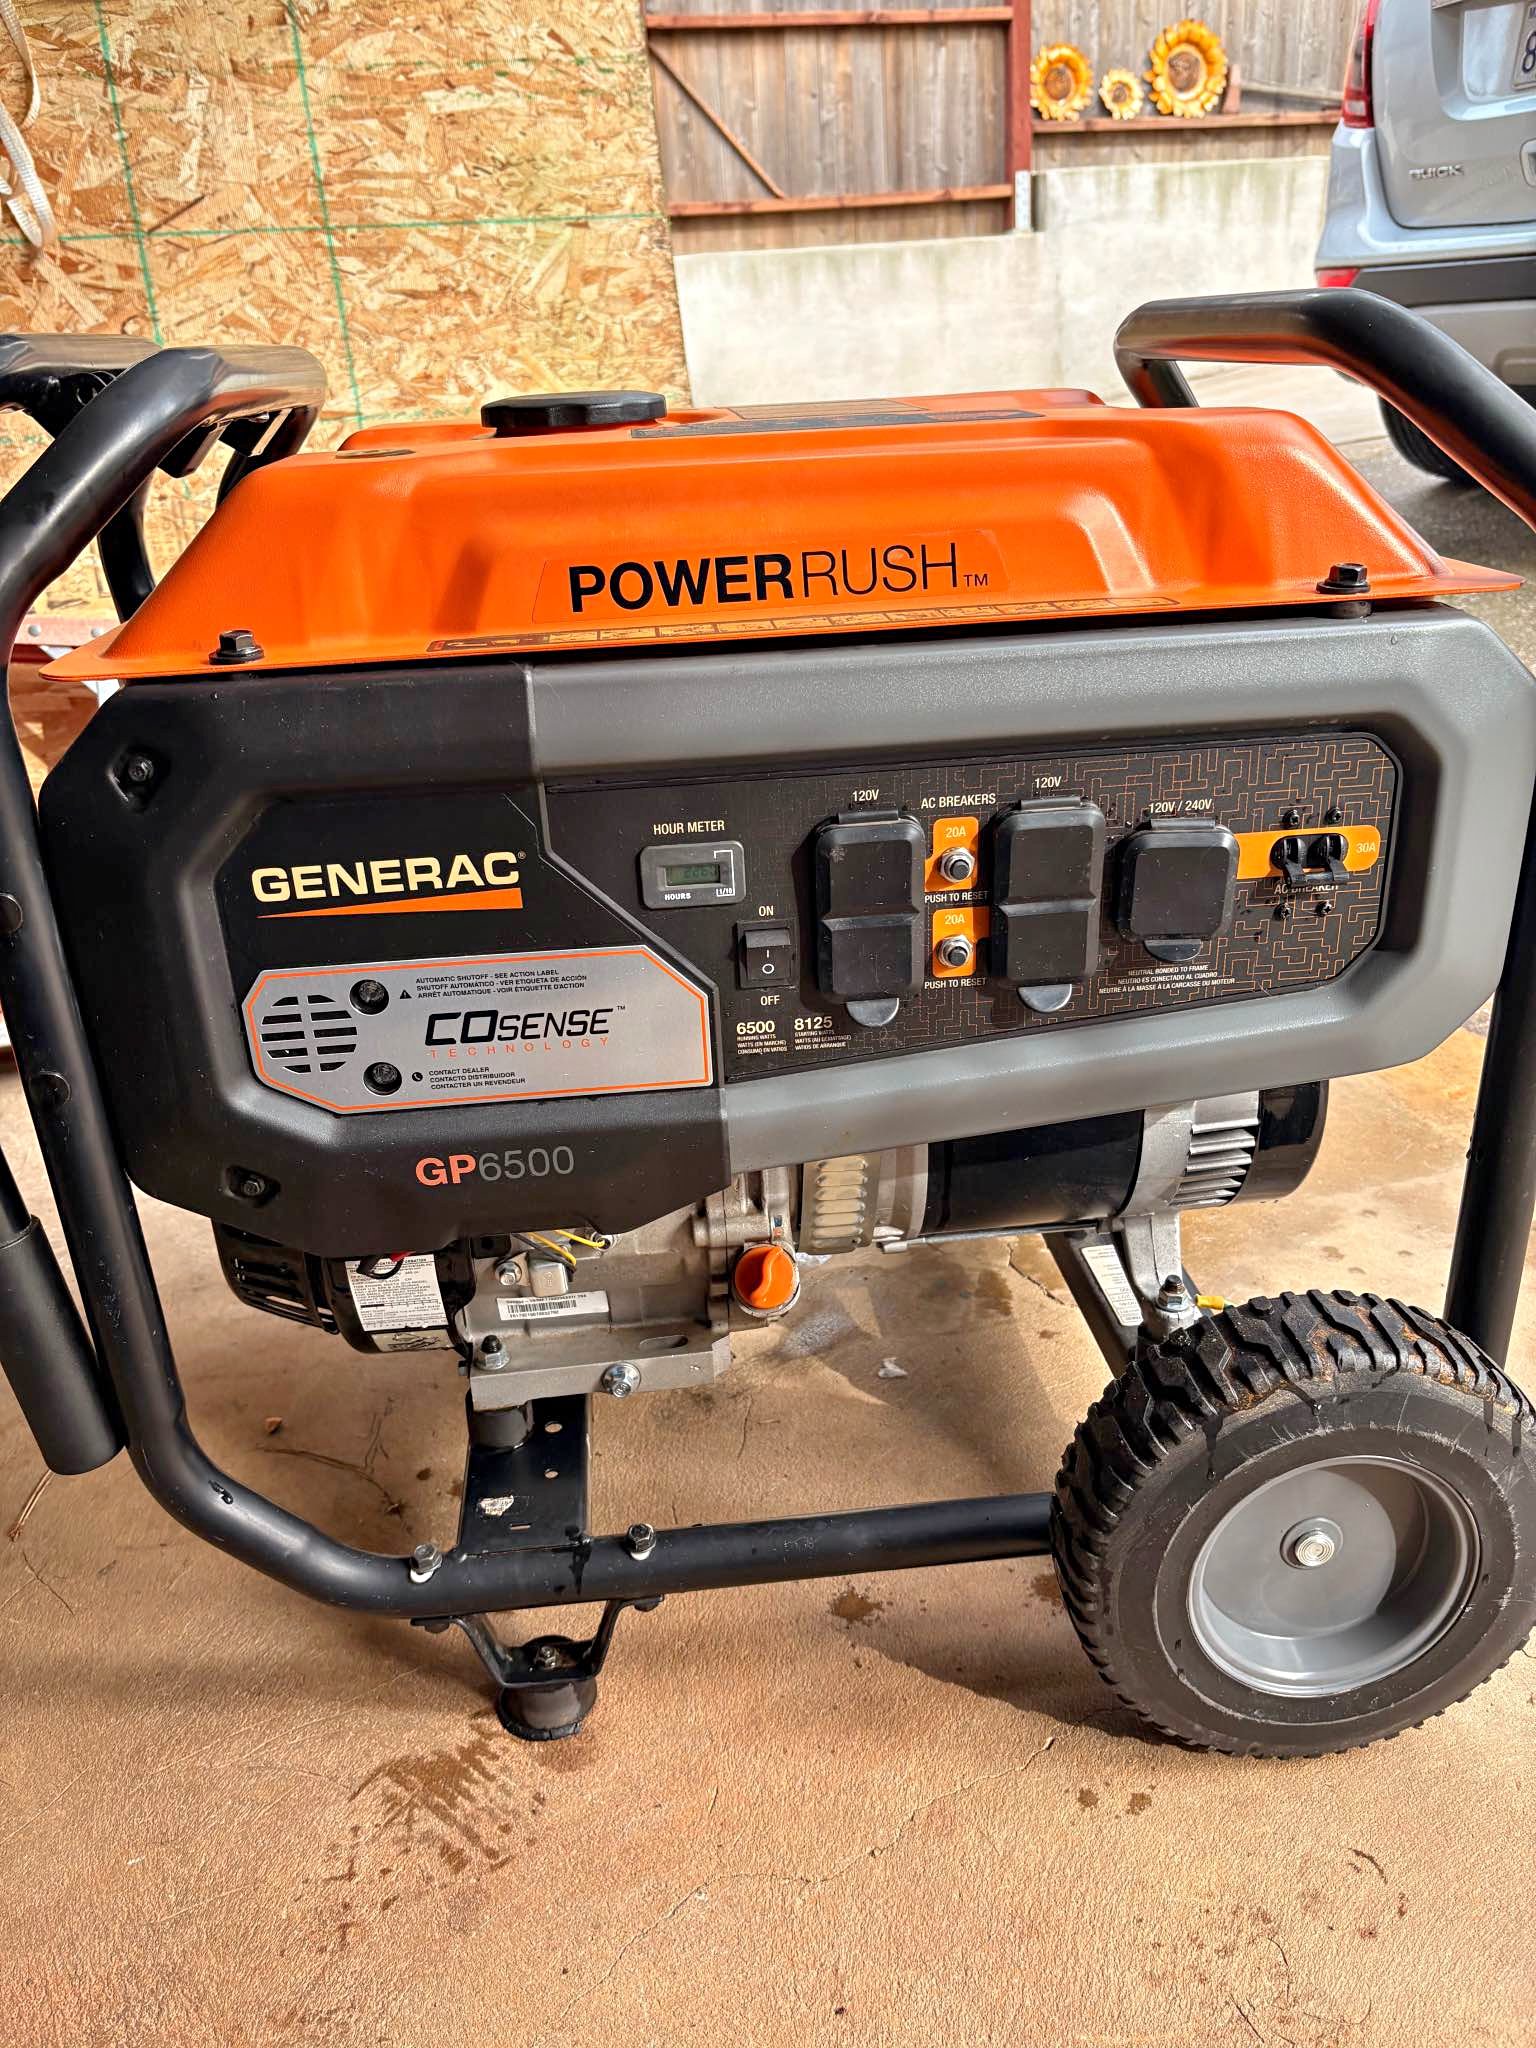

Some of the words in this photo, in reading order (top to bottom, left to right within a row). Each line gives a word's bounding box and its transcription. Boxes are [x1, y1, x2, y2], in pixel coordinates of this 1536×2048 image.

[569, 542, 958, 612] POWERRUSH
[1035, 776, 1062, 788] 120V
[852, 789, 879, 801] 120V
[921, 798, 936, 809] AC
[939, 793, 996, 808] BREAKERS
[1149, 802, 1175, 813] 120V
[1186, 799, 1212, 810] 240V
[654, 823, 684, 835] HOUR
[688, 820, 724, 833] METER
[946, 826, 966, 838] 20A
[1356, 843, 1376, 852] 30A
[252, 851, 519, 902] GENERAC
[664, 892, 692, 900] HOURS
[924, 893, 946, 903] PUSH
[950, 892, 960, 901] TO
[962, 890, 988, 900] RESET
[759, 906, 774, 916] ON
[944, 914, 964, 924] 20A
[416, 975, 455, 983] AUTOMATIC
[457, 973, 488, 981] SHUTOFF
[500, 978, 514, 986] VER
[515, 976, 548, 985] ETIQUETA
[924, 981, 946, 990] PUSH
[949, 980, 958, 988] TO
[961, 978, 986, 986] RESET
[442, 988, 492, 997] AUTOMATIQUE
[761, 995, 780, 1006] OFF
[425, 1008, 614, 1046] COSENSE
[736, 1020, 776, 1034] 6500
[794, 1016, 832, 1030] 8125
[431, 1037, 608, 1059] TECHNOLOGY
[428, 1068, 460, 1076] CONTACT
[462, 1066, 489, 1074] DEALER
[430, 1075, 466, 1083] CONTACTO
[468, 1072, 515, 1080] DISTRIBUIDOR
[431, 1082, 472, 1090] CONTACTER
[484, 1078, 526, 1086] REVENDEUR
[416, 1146, 574, 1186] GP6500
